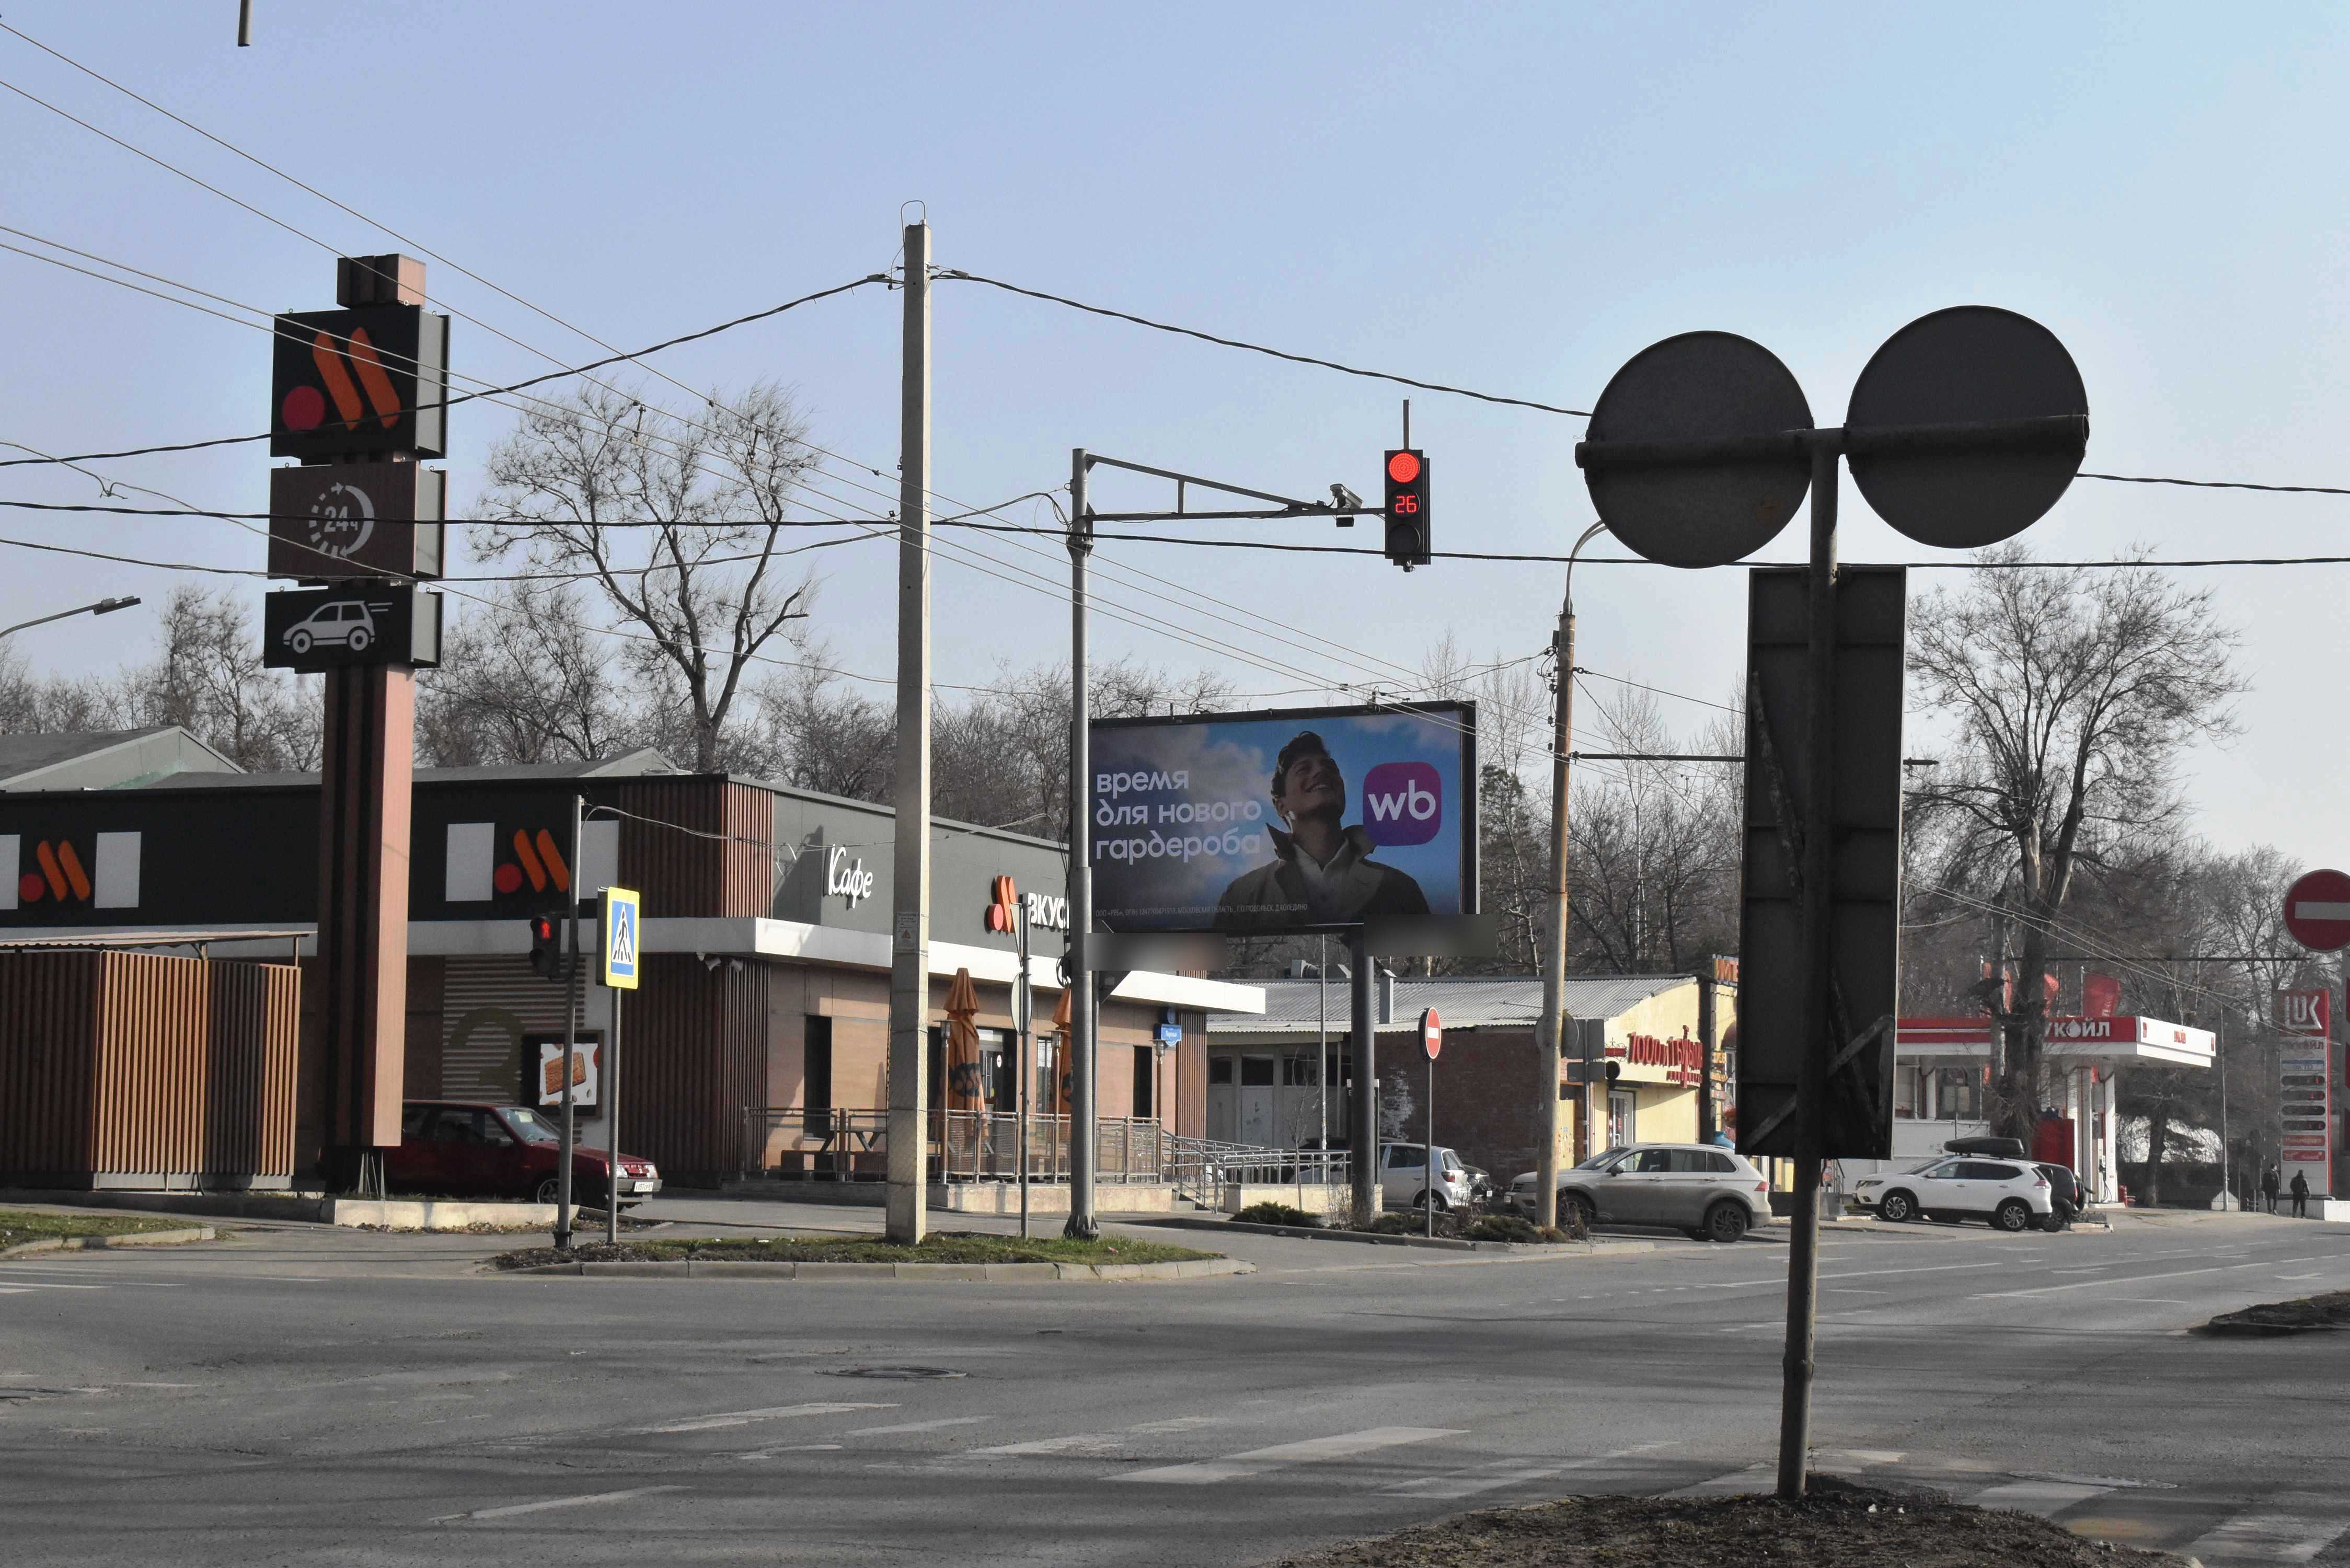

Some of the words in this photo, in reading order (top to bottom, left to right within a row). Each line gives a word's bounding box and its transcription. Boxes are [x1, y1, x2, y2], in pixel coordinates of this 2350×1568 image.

[1395, 495, 1417, 513] 26
[1097, 770, 1189, 799] время
[1367, 779, 1436, 821] wb
[1096, 799, 1148, 826] для
[1158, 800, 1262, 824] нового
[1096, 827, 1261, 866] гардероба
[828, 844, 873, 908] Кафе
